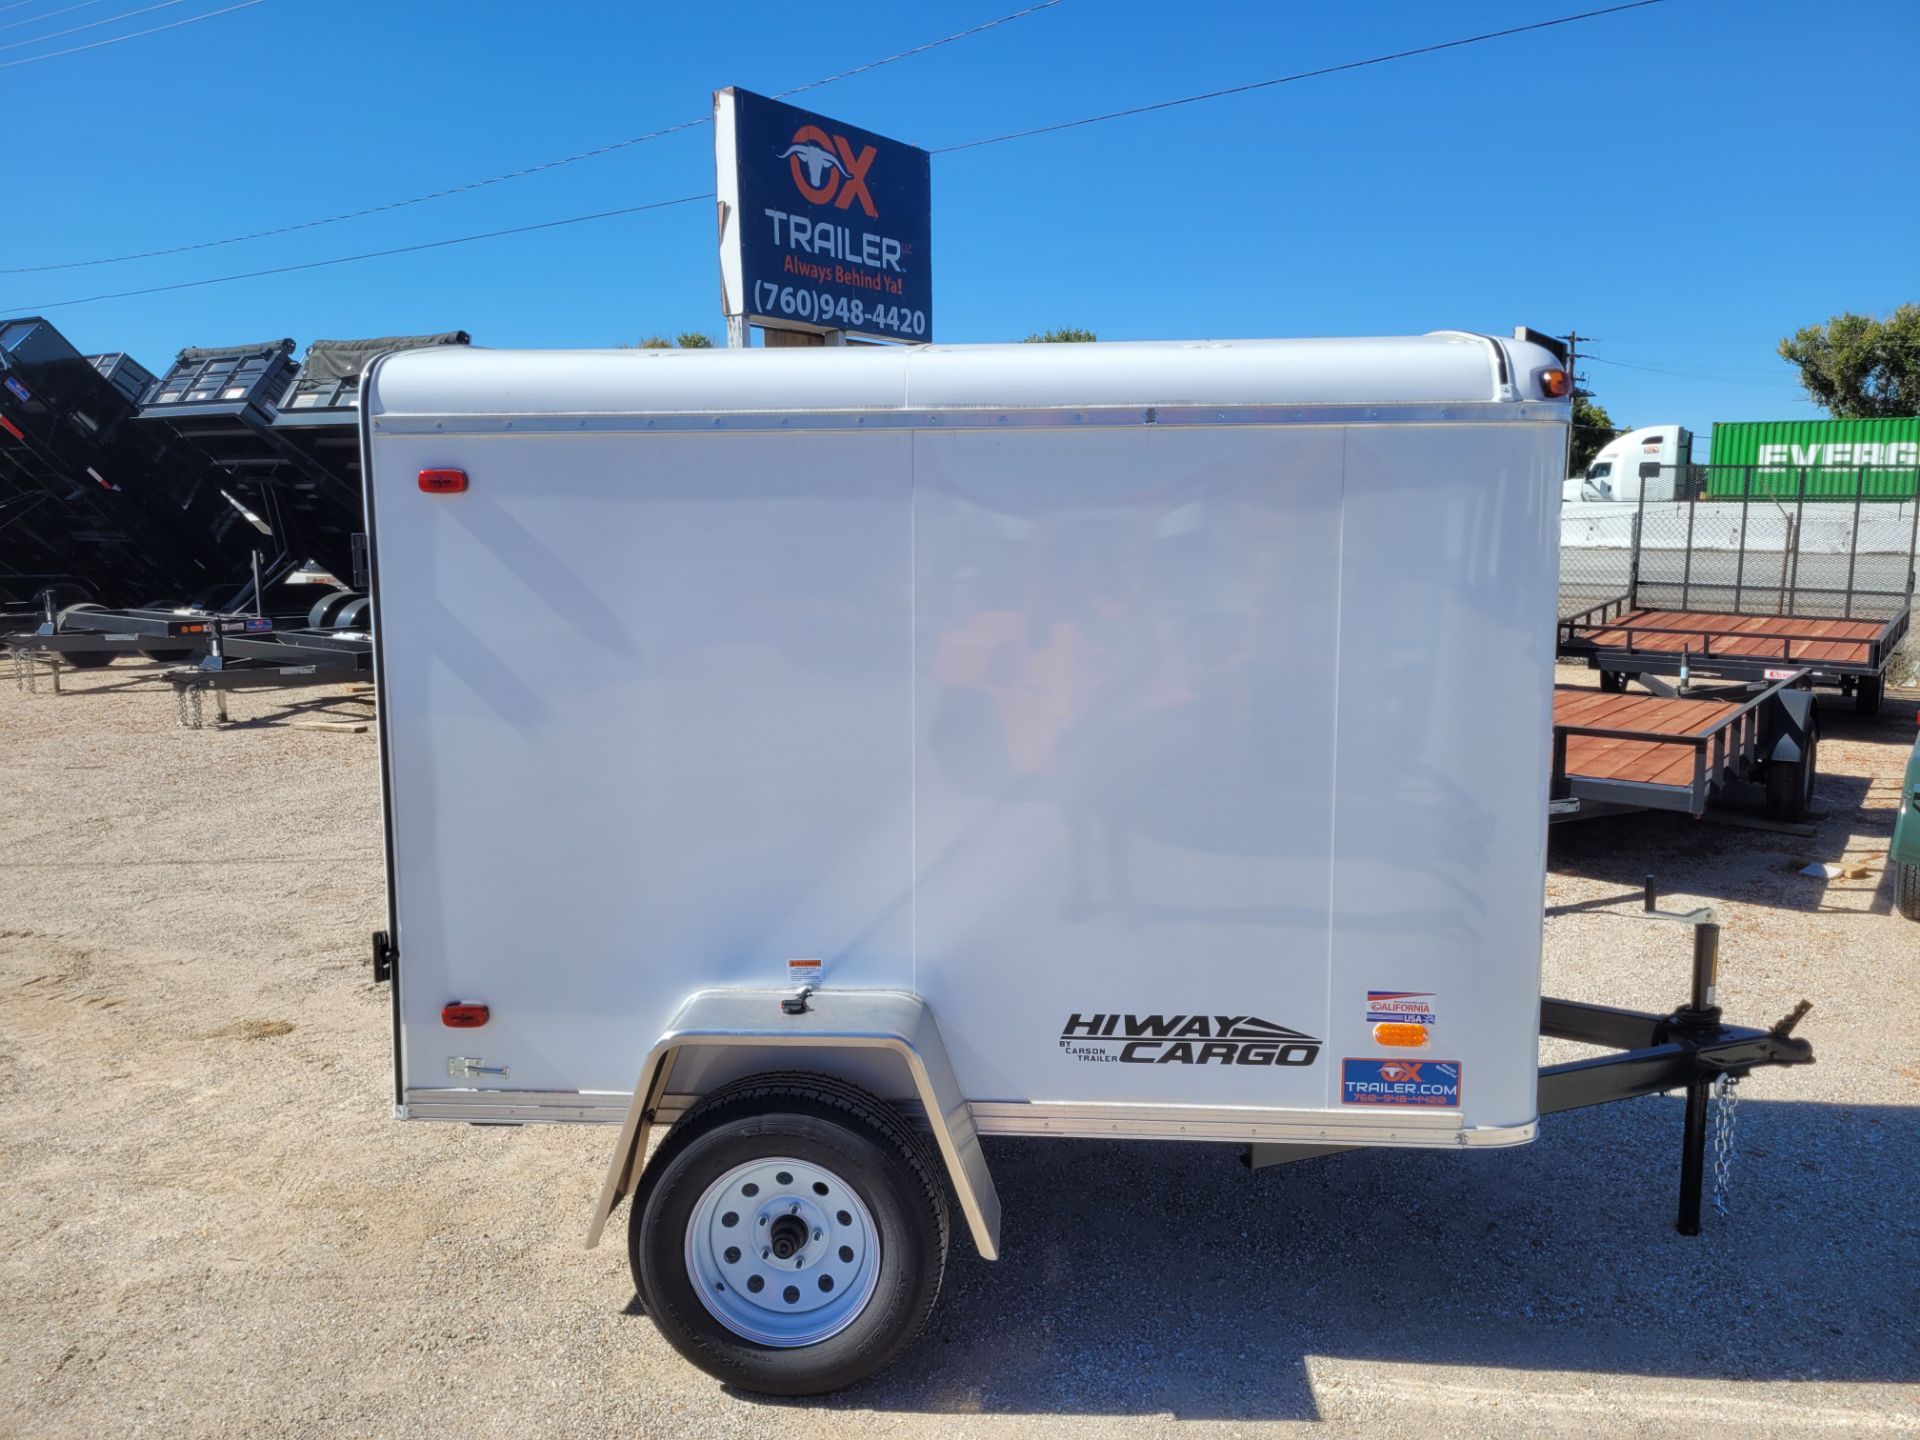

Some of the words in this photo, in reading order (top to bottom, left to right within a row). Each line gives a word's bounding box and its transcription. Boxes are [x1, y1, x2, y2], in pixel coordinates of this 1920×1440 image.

[789, 125, 879, 218] OX
[765, 208, 901, 272] TRAILER
[784, 255, 832, 284] Always
[835, 265, 881, 291] Behind
[883, 273, 903, 294] Ya!
[754, 280, 926, 335] (760)948-4420
[1758, 443, 1918, 473] EVERG
[1062, 1013, 1250, 1037] HIWAY
[1404, 1014, 1422, 1023] USA
[1065, 1047, 1106, 1055] CARSON
[1118, 1041, 1321, 1067] CARGO
[1380, 1062, 1423, 1082] OX
[1345, 1081, 1457, 1095] TRAILER.COM
